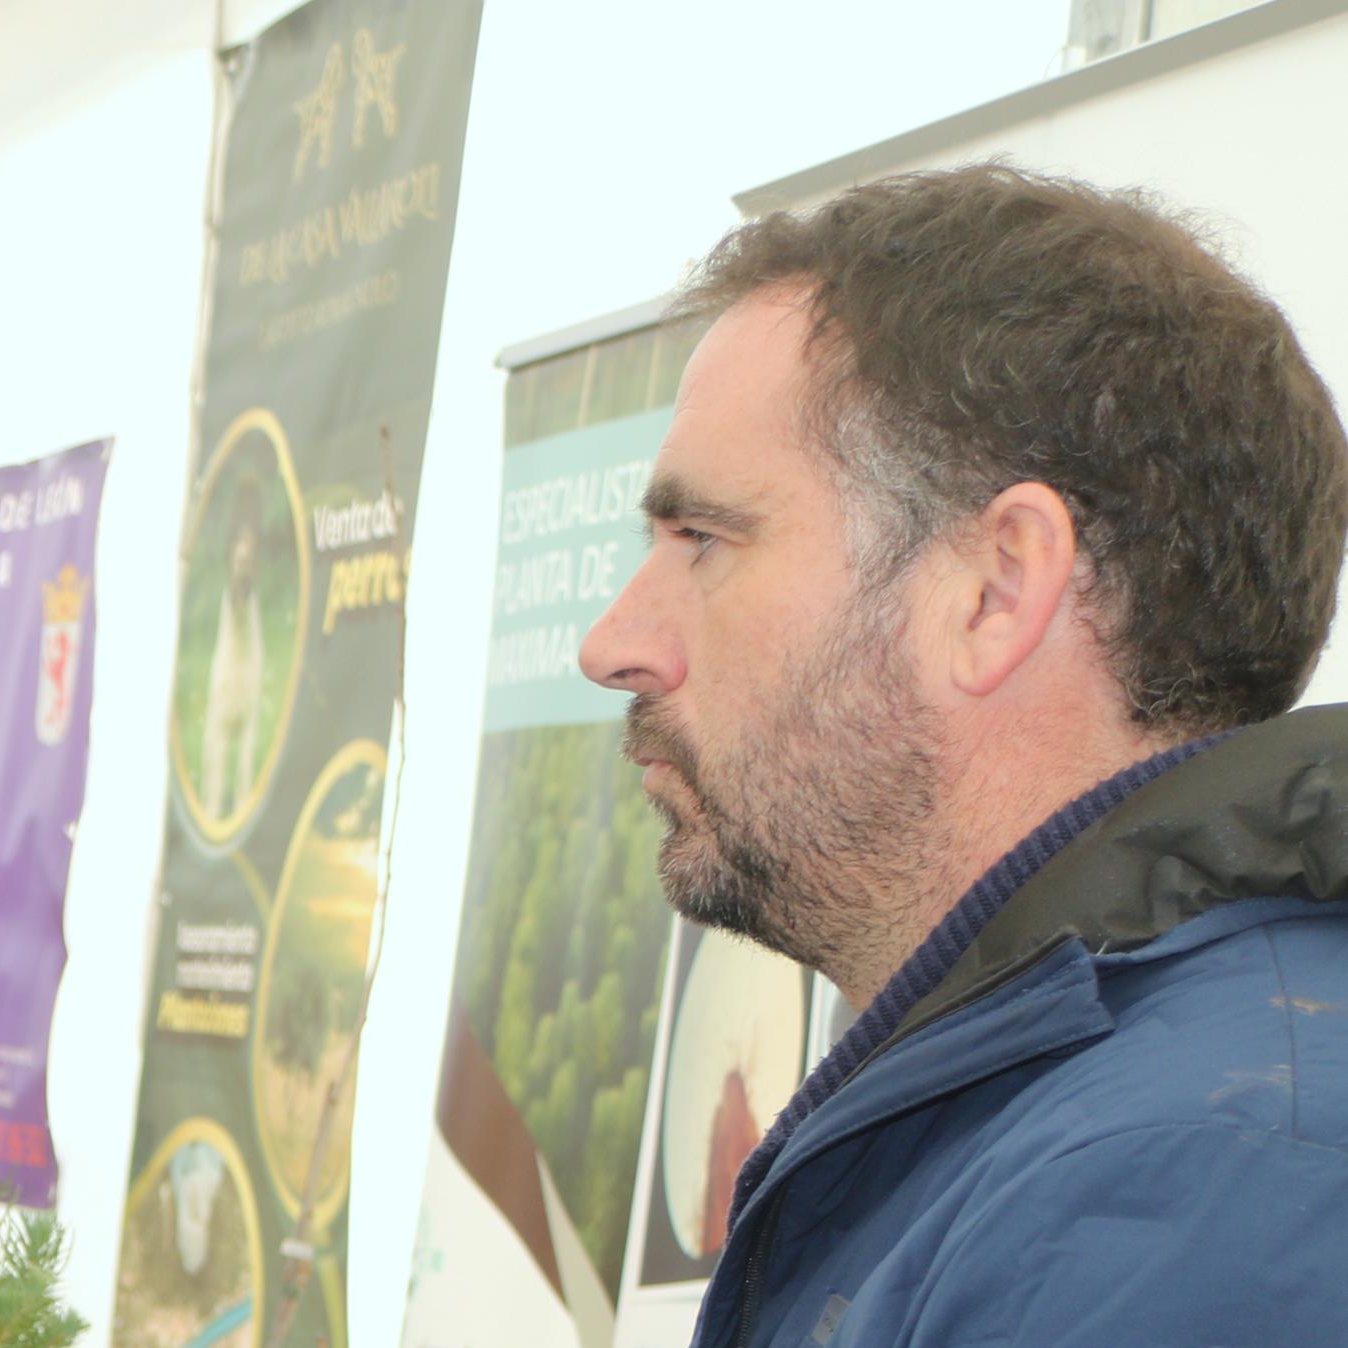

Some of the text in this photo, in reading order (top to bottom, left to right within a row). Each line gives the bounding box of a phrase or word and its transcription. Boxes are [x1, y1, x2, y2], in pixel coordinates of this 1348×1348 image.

[314, 495, 369, 552] Venta
[497, 546, 618, 616] PLANTA DE
